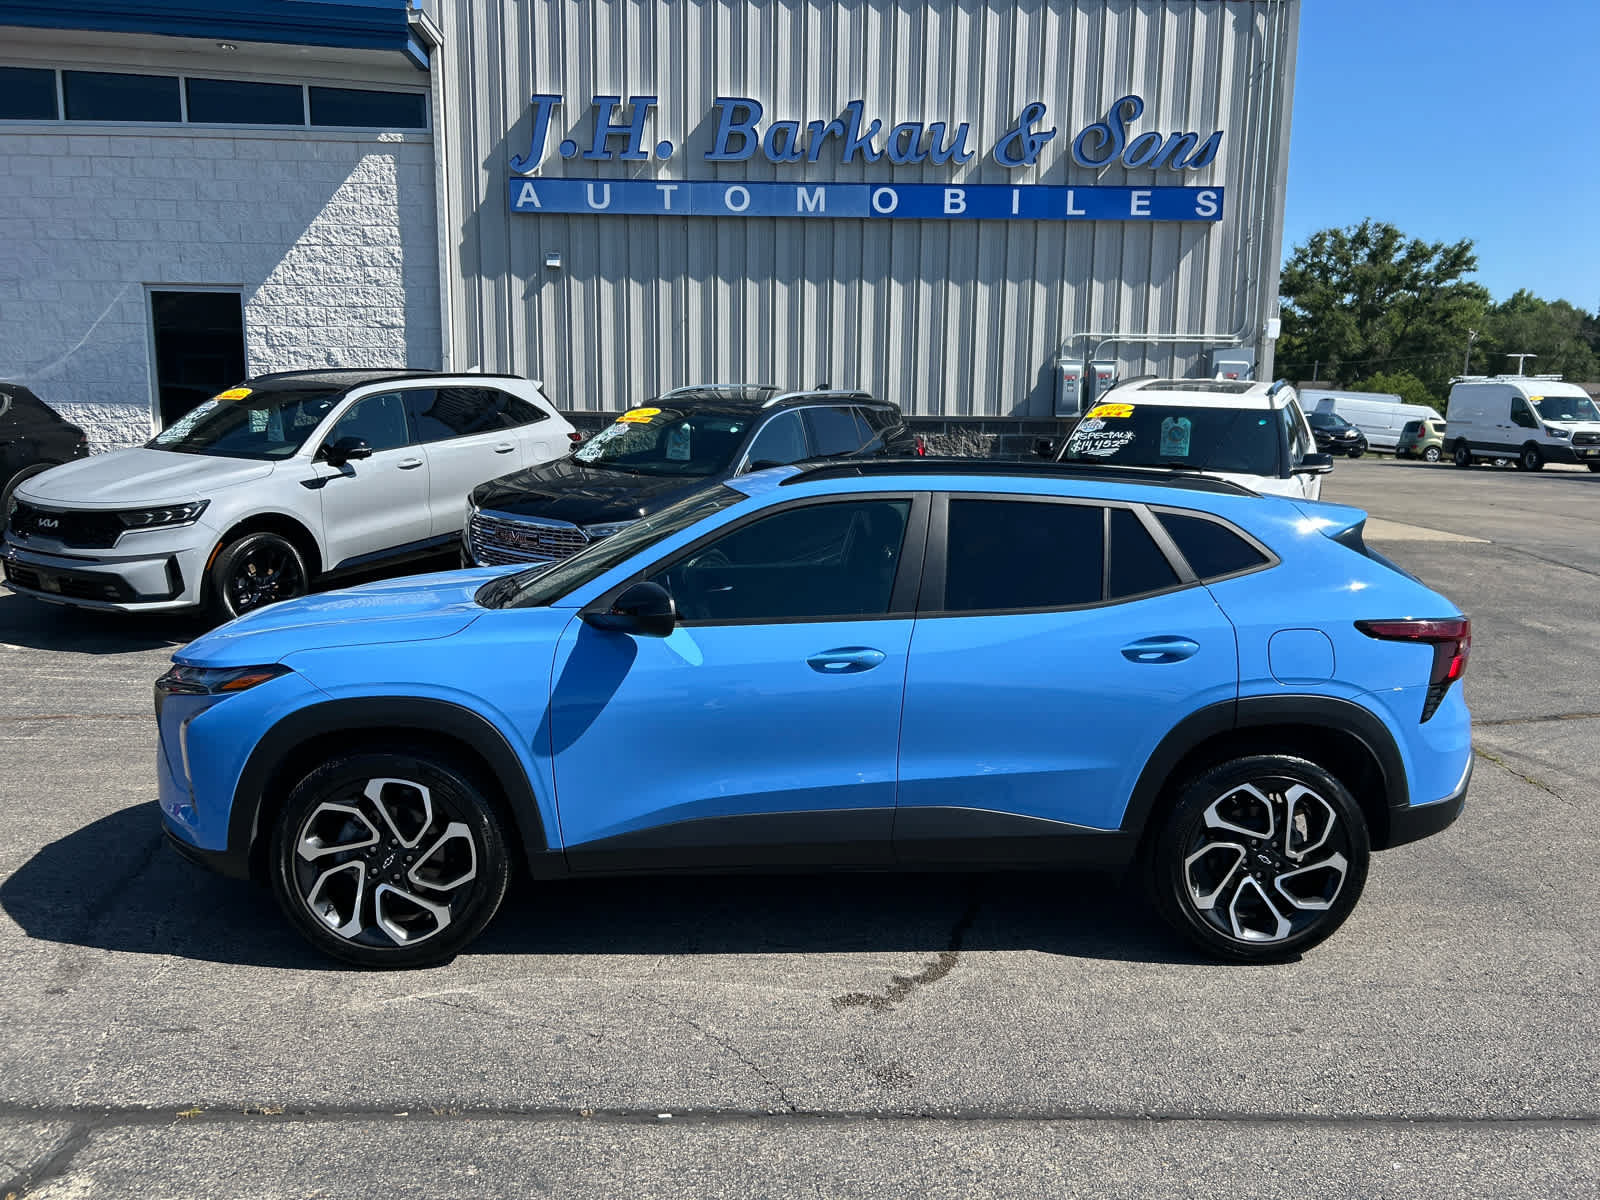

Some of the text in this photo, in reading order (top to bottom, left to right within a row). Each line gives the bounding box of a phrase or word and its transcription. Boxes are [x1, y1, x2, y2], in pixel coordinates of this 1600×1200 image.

[510, 93, 1224, 175] J.H. Barkau & Sons
[496, 527, 539, 547] MC
